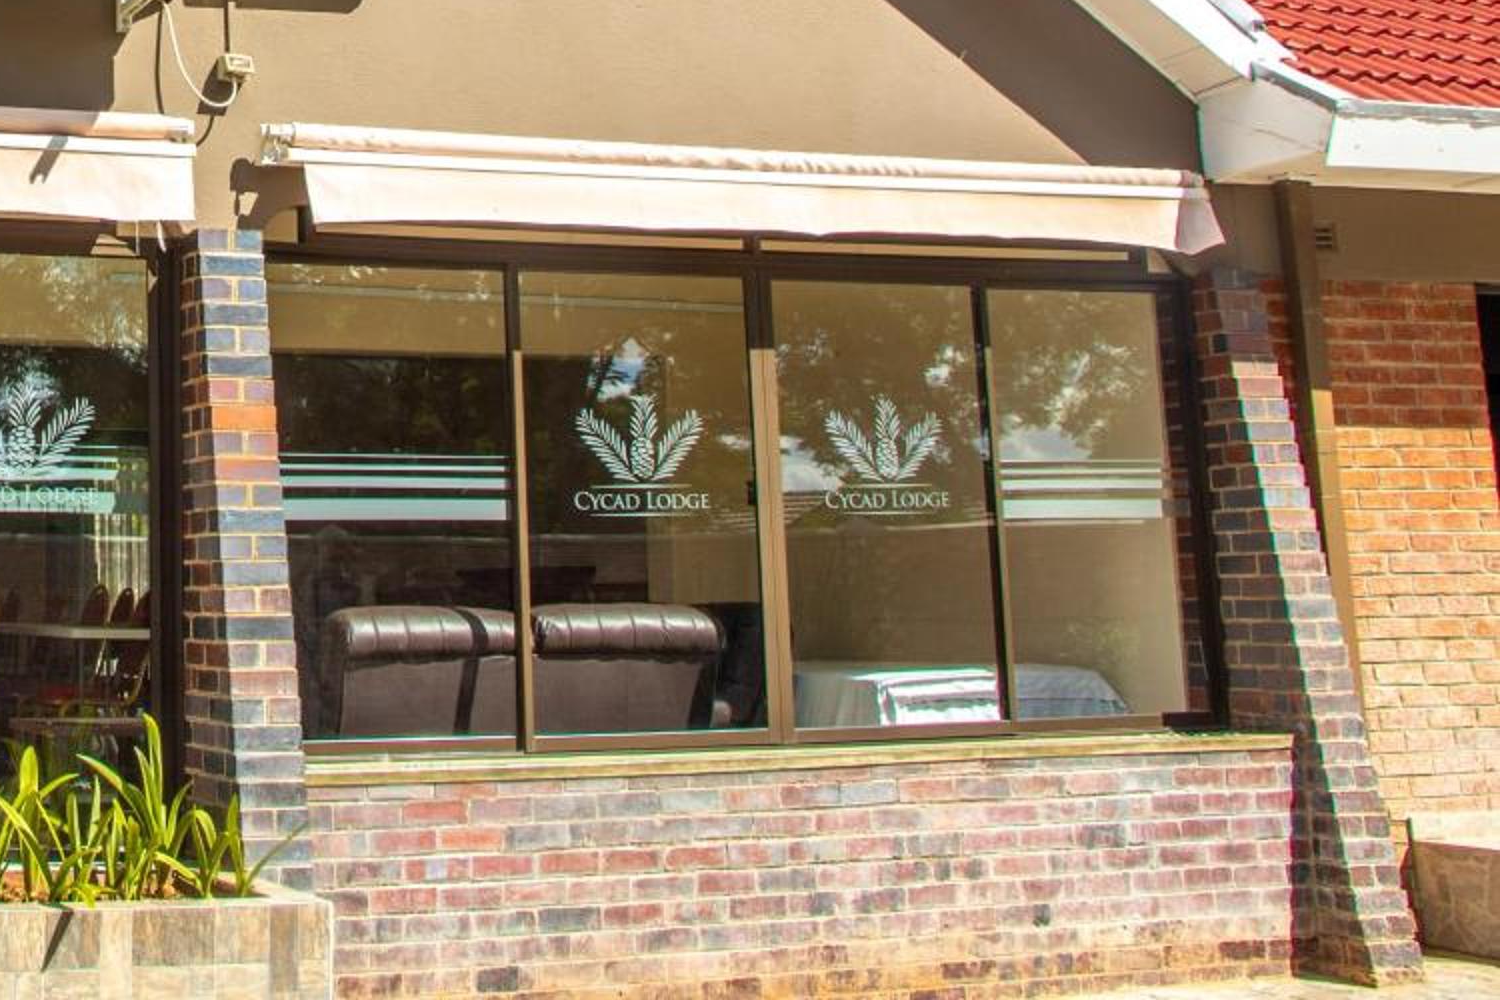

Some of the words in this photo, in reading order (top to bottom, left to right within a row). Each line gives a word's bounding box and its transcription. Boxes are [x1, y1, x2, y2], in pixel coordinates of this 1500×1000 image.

[573, 490, 640, 511] CYCAD
[646, 490, 711, 510] LODGE
[825, 490, 886, 509] CYCAD
[891, 489, 949, 508] LODGE
